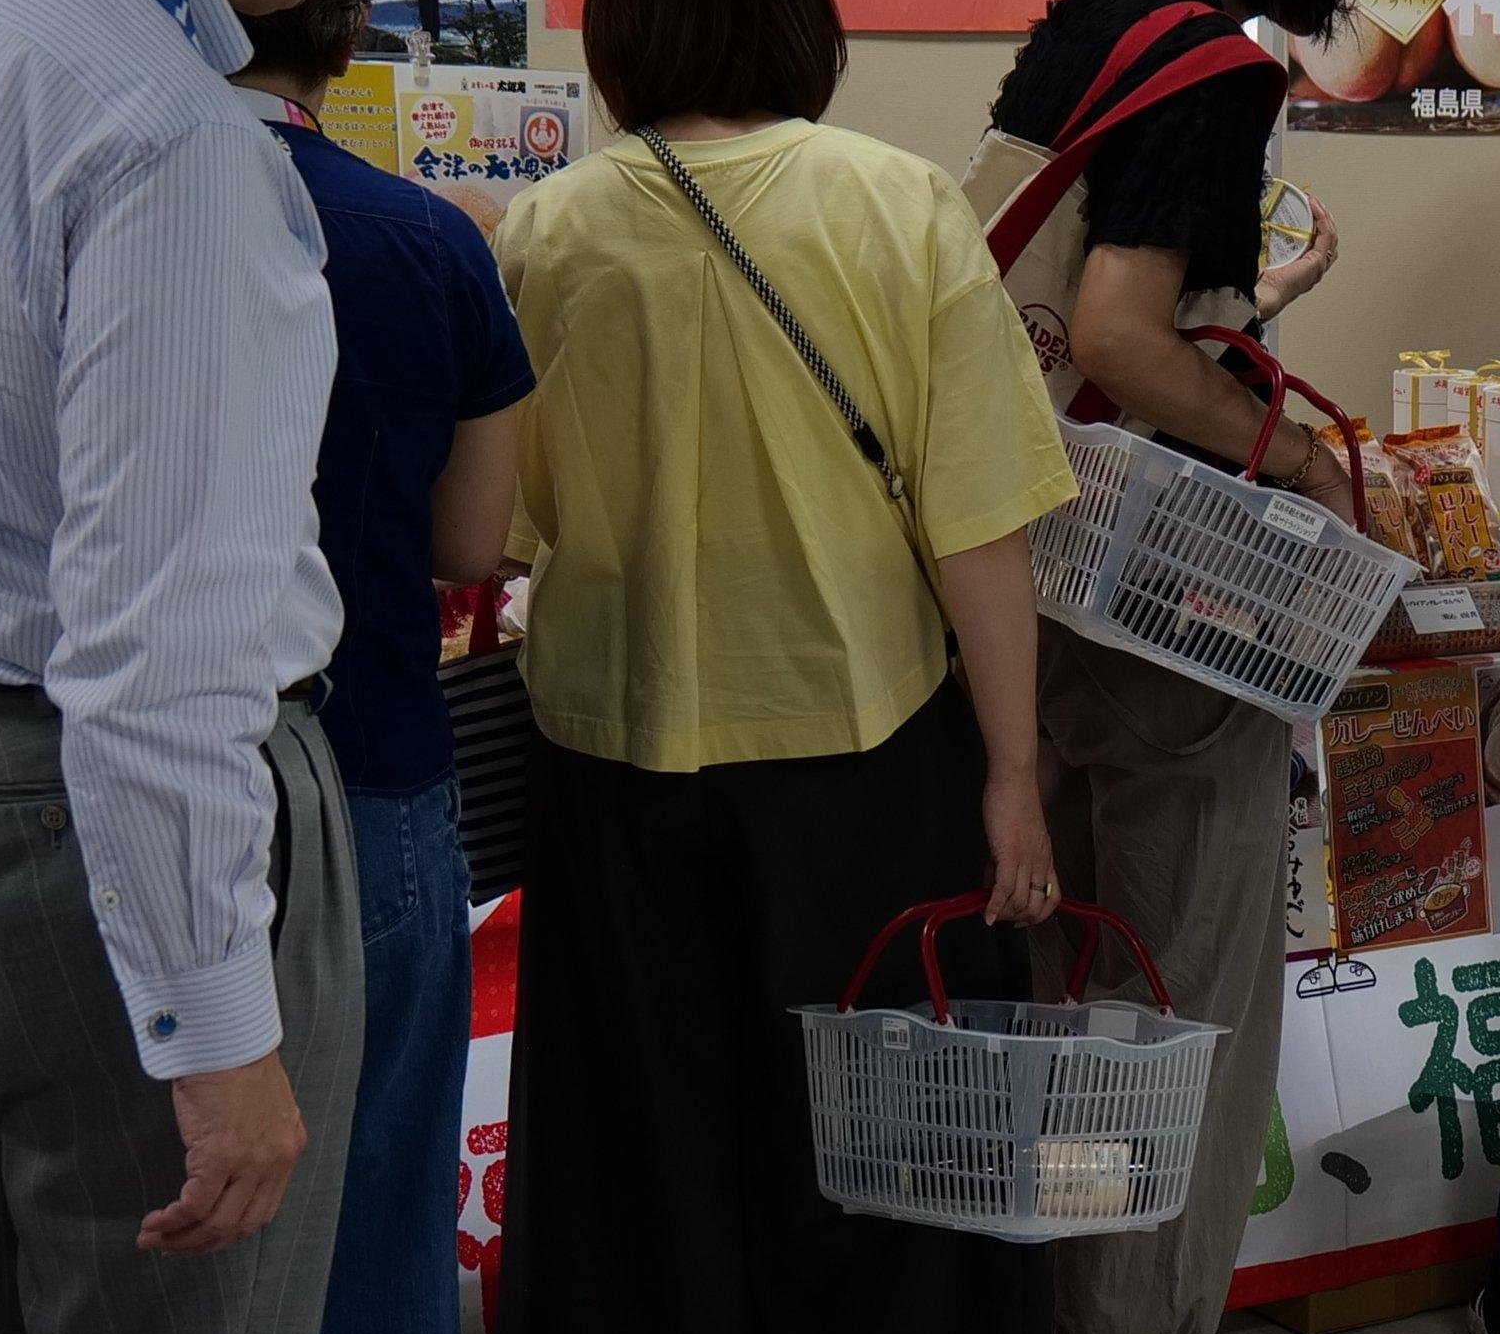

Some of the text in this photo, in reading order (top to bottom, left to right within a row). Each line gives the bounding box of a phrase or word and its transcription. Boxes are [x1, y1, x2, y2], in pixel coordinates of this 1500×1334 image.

[1411, 87, 1485, 120] 福島県
[1327, 706, 1476, 746] カレーせんべい
